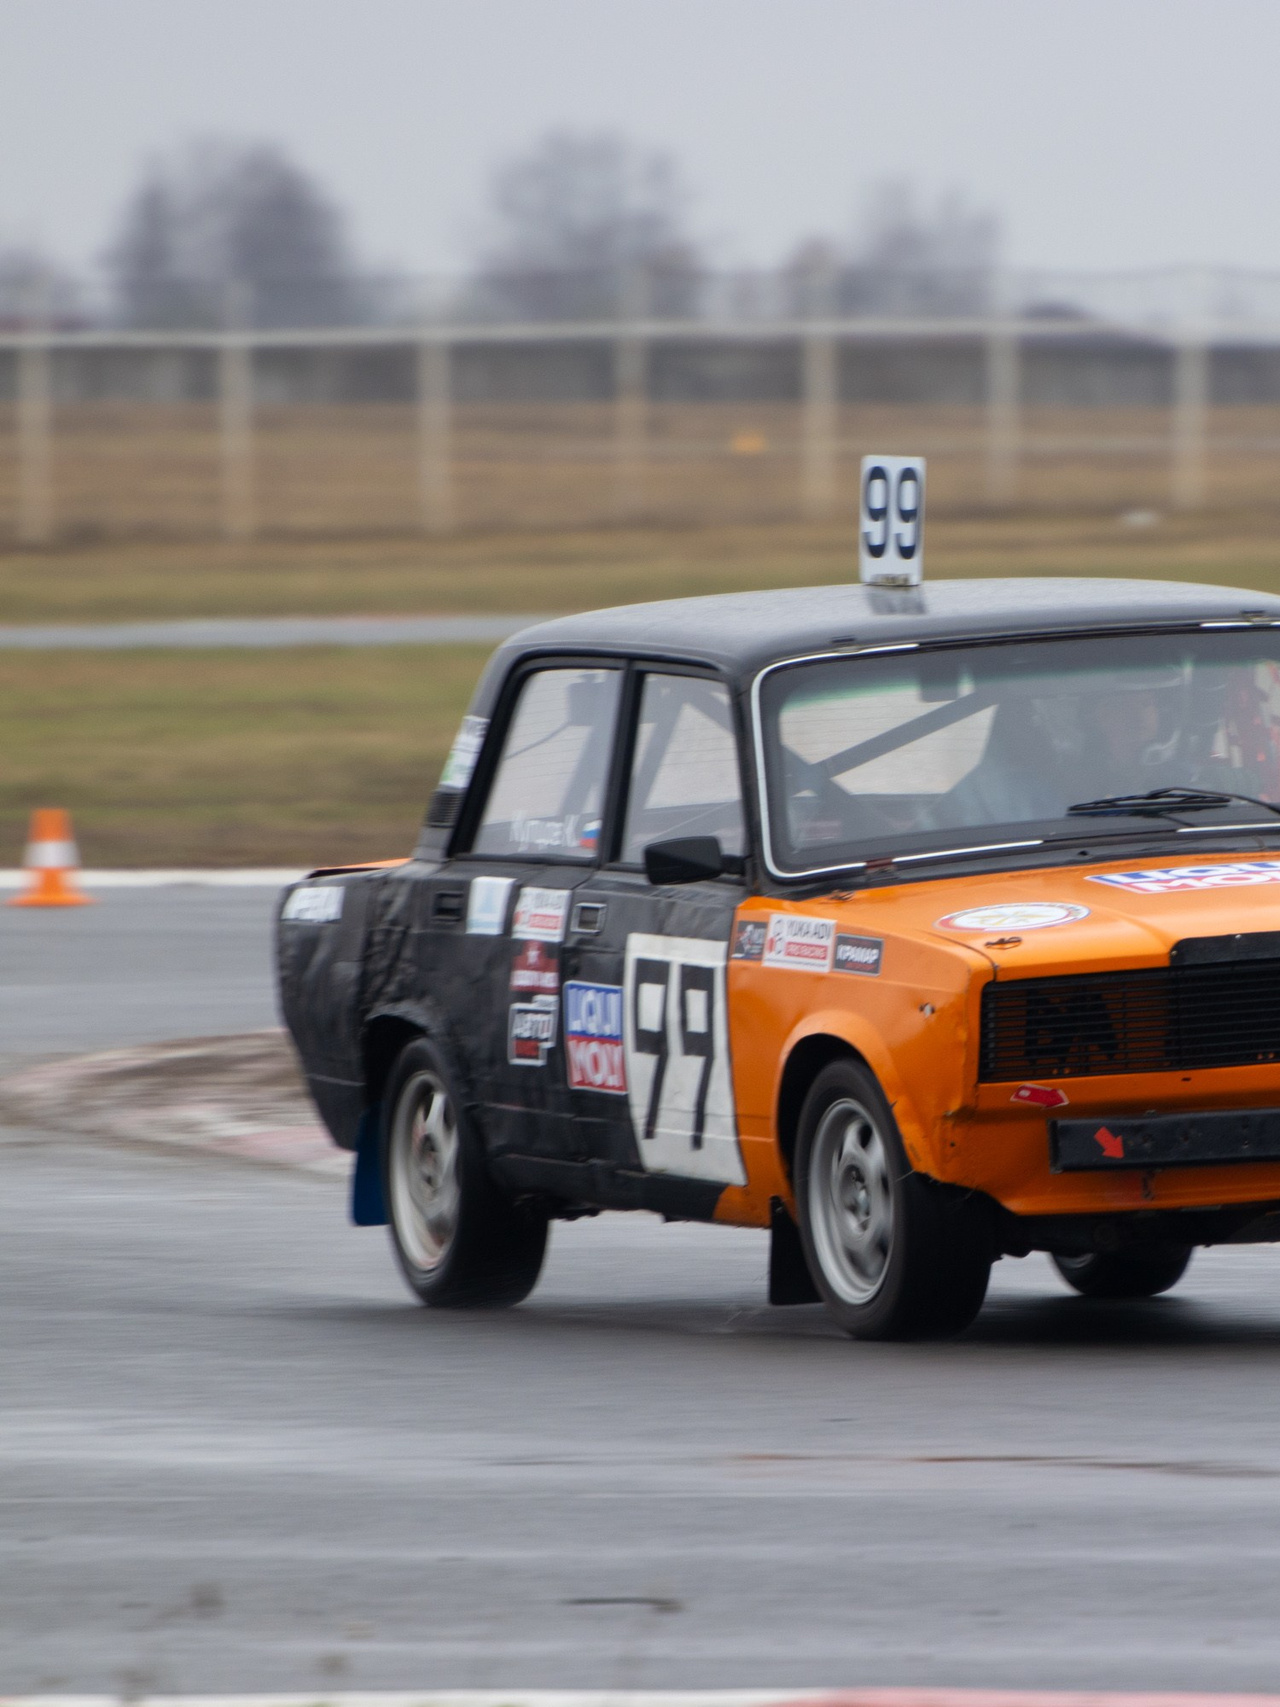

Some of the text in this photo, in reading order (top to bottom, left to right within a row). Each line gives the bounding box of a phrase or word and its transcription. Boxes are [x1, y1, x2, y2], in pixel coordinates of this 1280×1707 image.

[863, 466, 922, 559] 99
[568, 988, 621, 1036] LIQUI
[568, 1040, 625, 1087] MOLY
[635, 958, 715, 1150] 99
